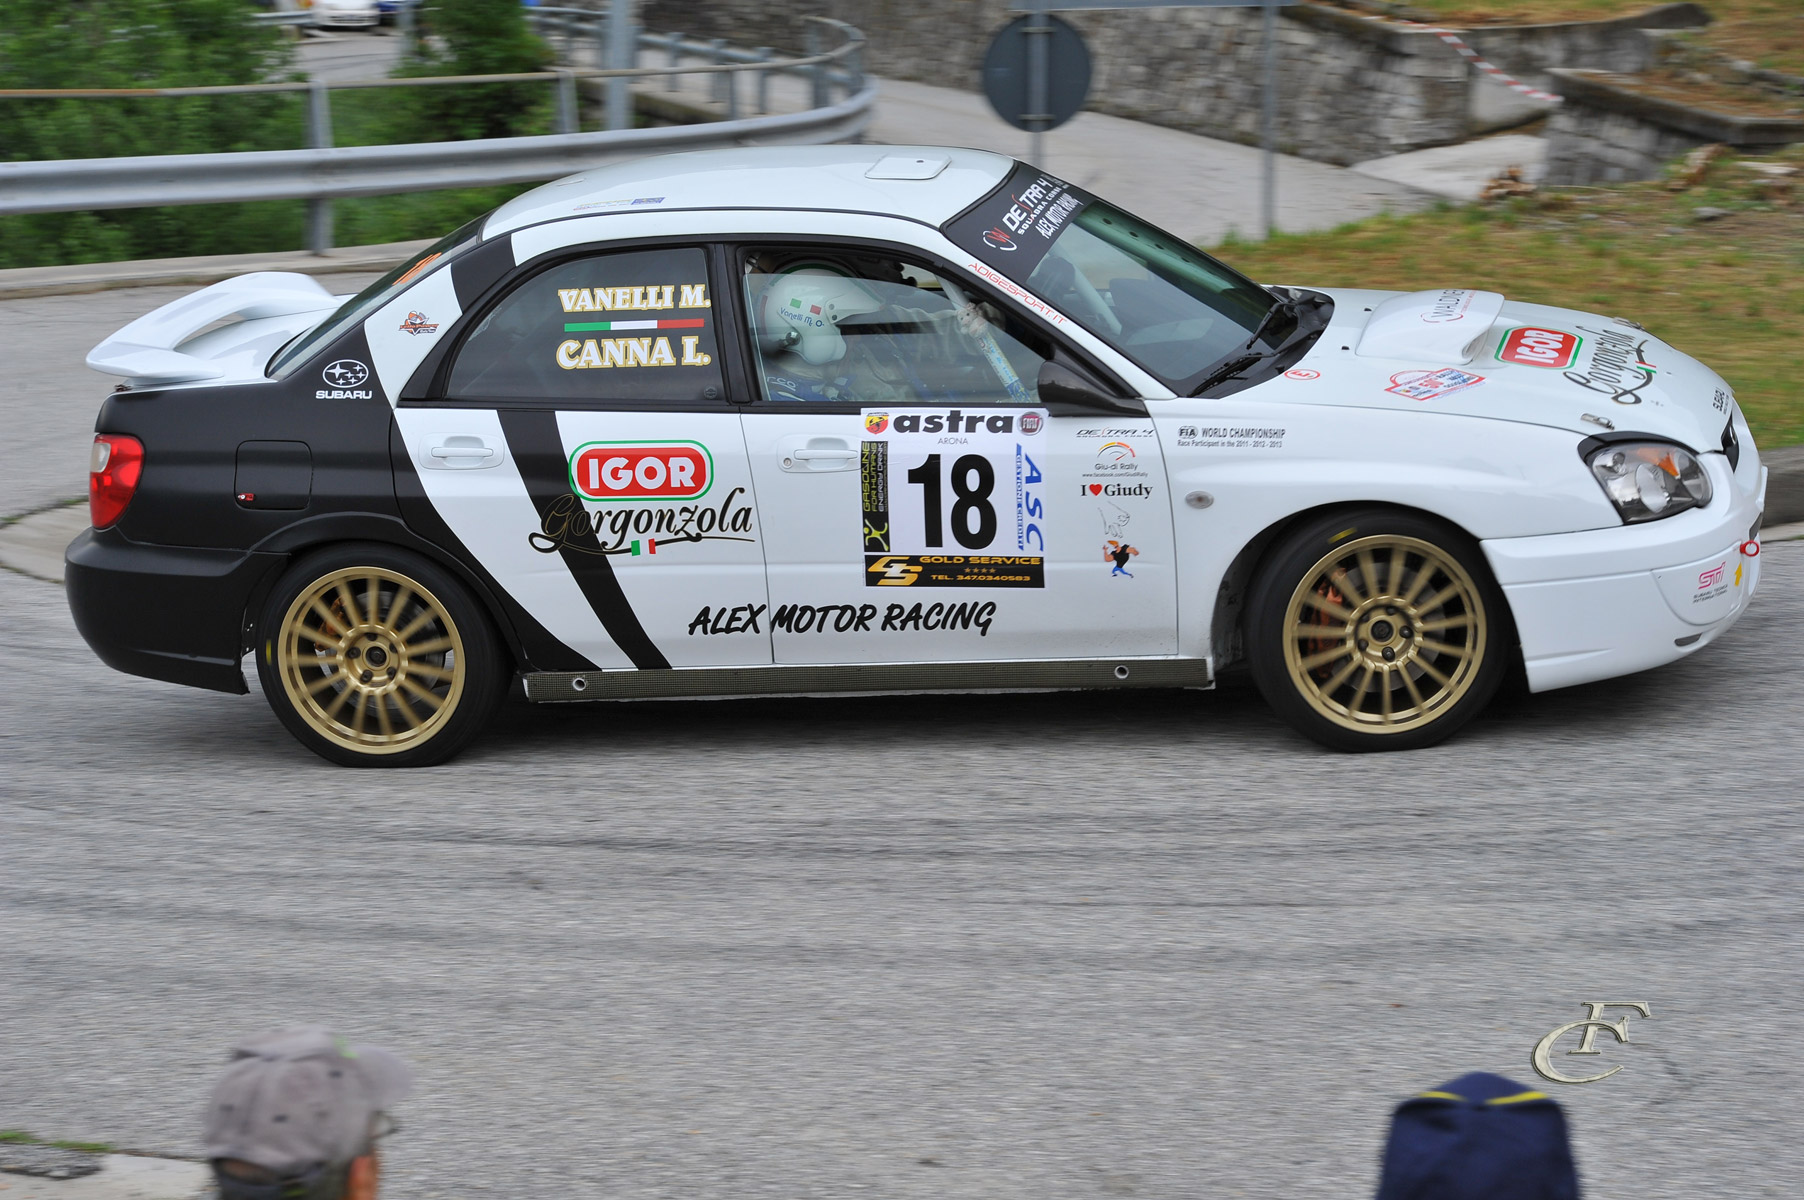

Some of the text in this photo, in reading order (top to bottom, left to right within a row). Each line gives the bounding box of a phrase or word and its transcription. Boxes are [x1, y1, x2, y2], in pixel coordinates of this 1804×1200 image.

[1017, 202, 1048, 235] SQUADRA
[558, 284, 711, 312] VANELLI M.
[556, 336, 711, 370] CANNA L.
[1514, 329, 1564, 364] IGOR
[315, 390, 372, 399] SUBARU
[893, 410, 1014, 434] astra
[1201, 428, 1228, 438] WORLD
[1229, 428, 1286, 439] CHAMPIONSHIP
[937, 437, 969, 445] ARONA
[1177, 439, 1190, 447] Race
[1191, 439, 1219, 448] Participant
[588, 456, 696, 490] IGOR
[862, 441, 871, 512] GASOLINE
[870, 442, 878, 488] HUMANS
[1120, 462, 1138, 472] Rally
[908, 453, 997, 550] 18
[1025, 453, 1044, 552] ASC
[1080, 483, 1153, 499] I Giudy
[528, 487, 755, 555] Gorgonzola
[919, 556, 1041, 565] GOLD SERVICE
[687, 601, 997, 637] ALEX MOTOR RACING
